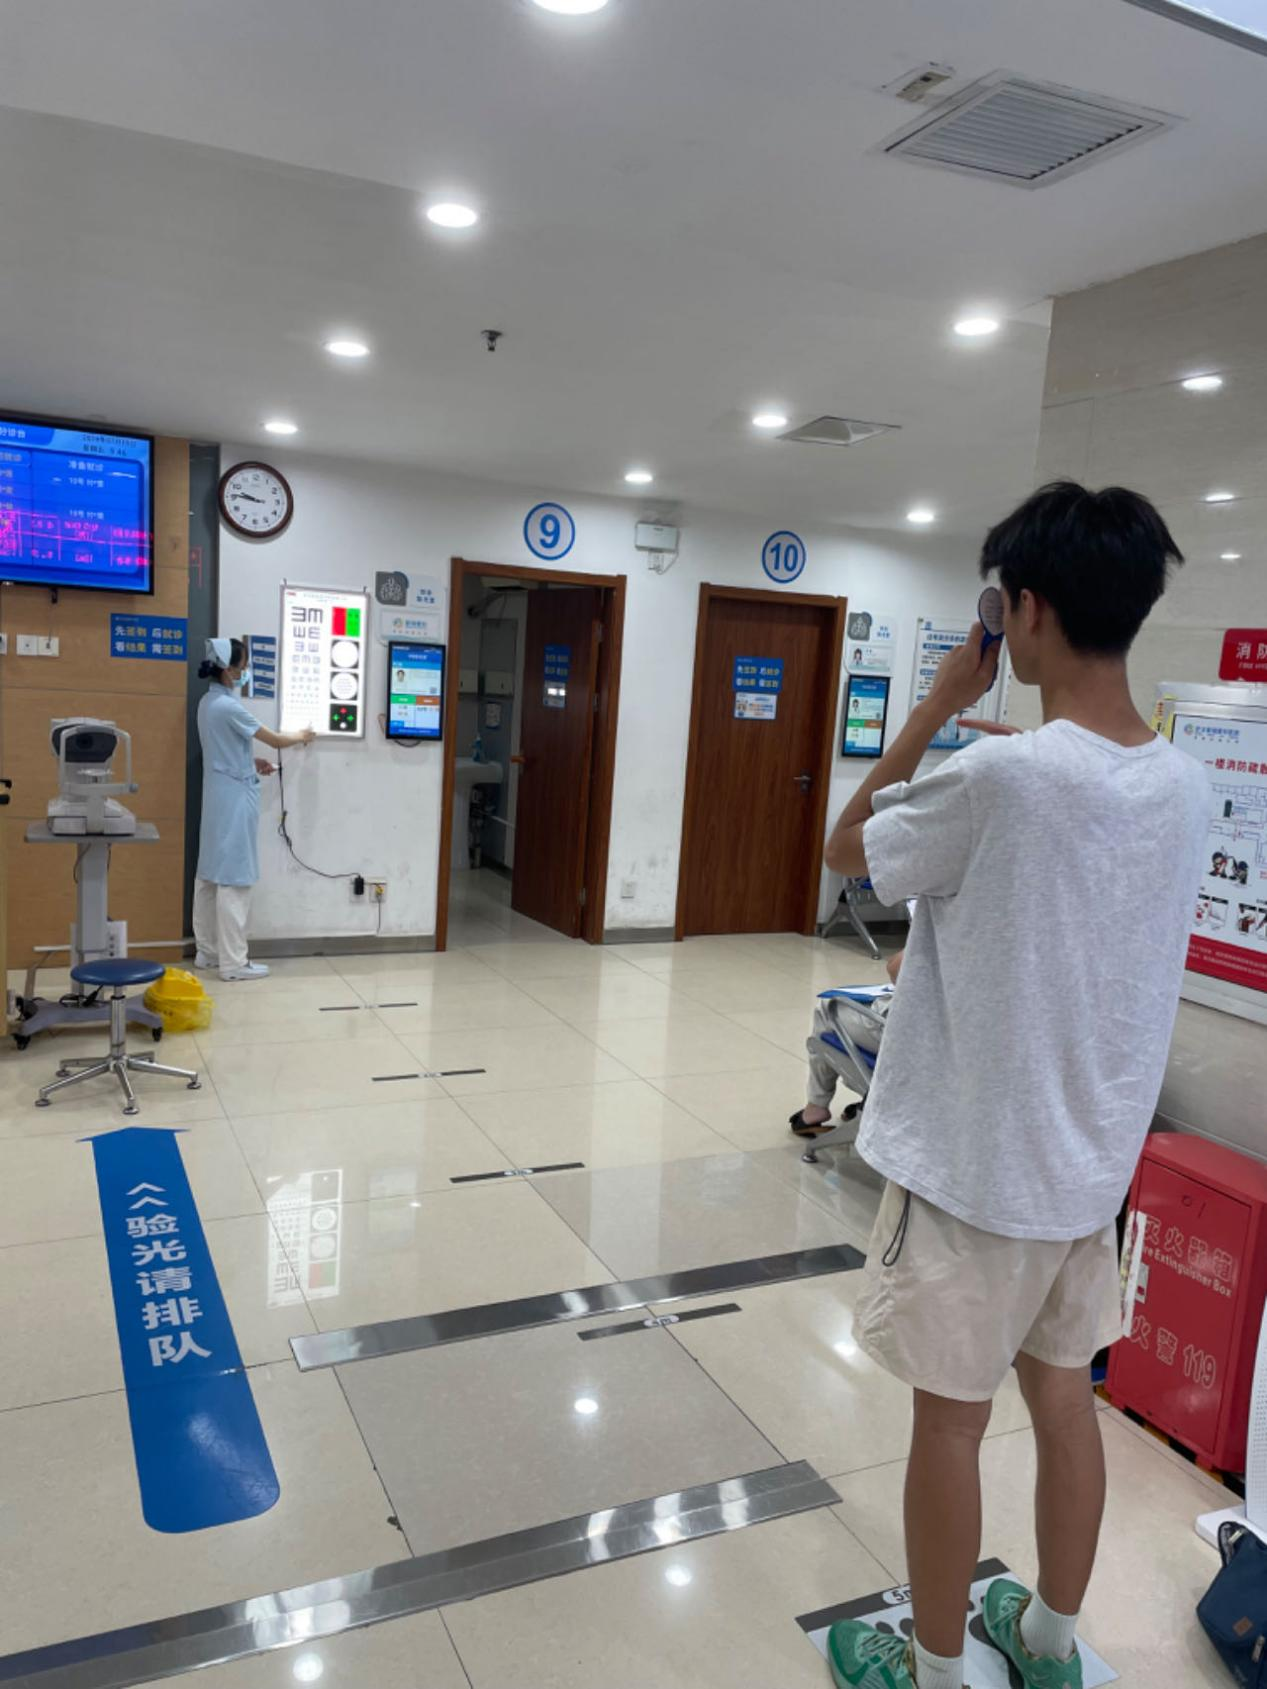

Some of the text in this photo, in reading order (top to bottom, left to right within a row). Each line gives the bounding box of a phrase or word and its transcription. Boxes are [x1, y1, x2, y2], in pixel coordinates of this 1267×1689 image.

[539, 512, 561, 549] 9
[769, 542, 799, 573] 10
[114, 625, 147, 638] 先签到
[125, 1213, 212, 1367] 验光请排队
[1154, 1246, 1212, 1287] Extinguisher
[1212, 1279, 1233, 1298] Box
